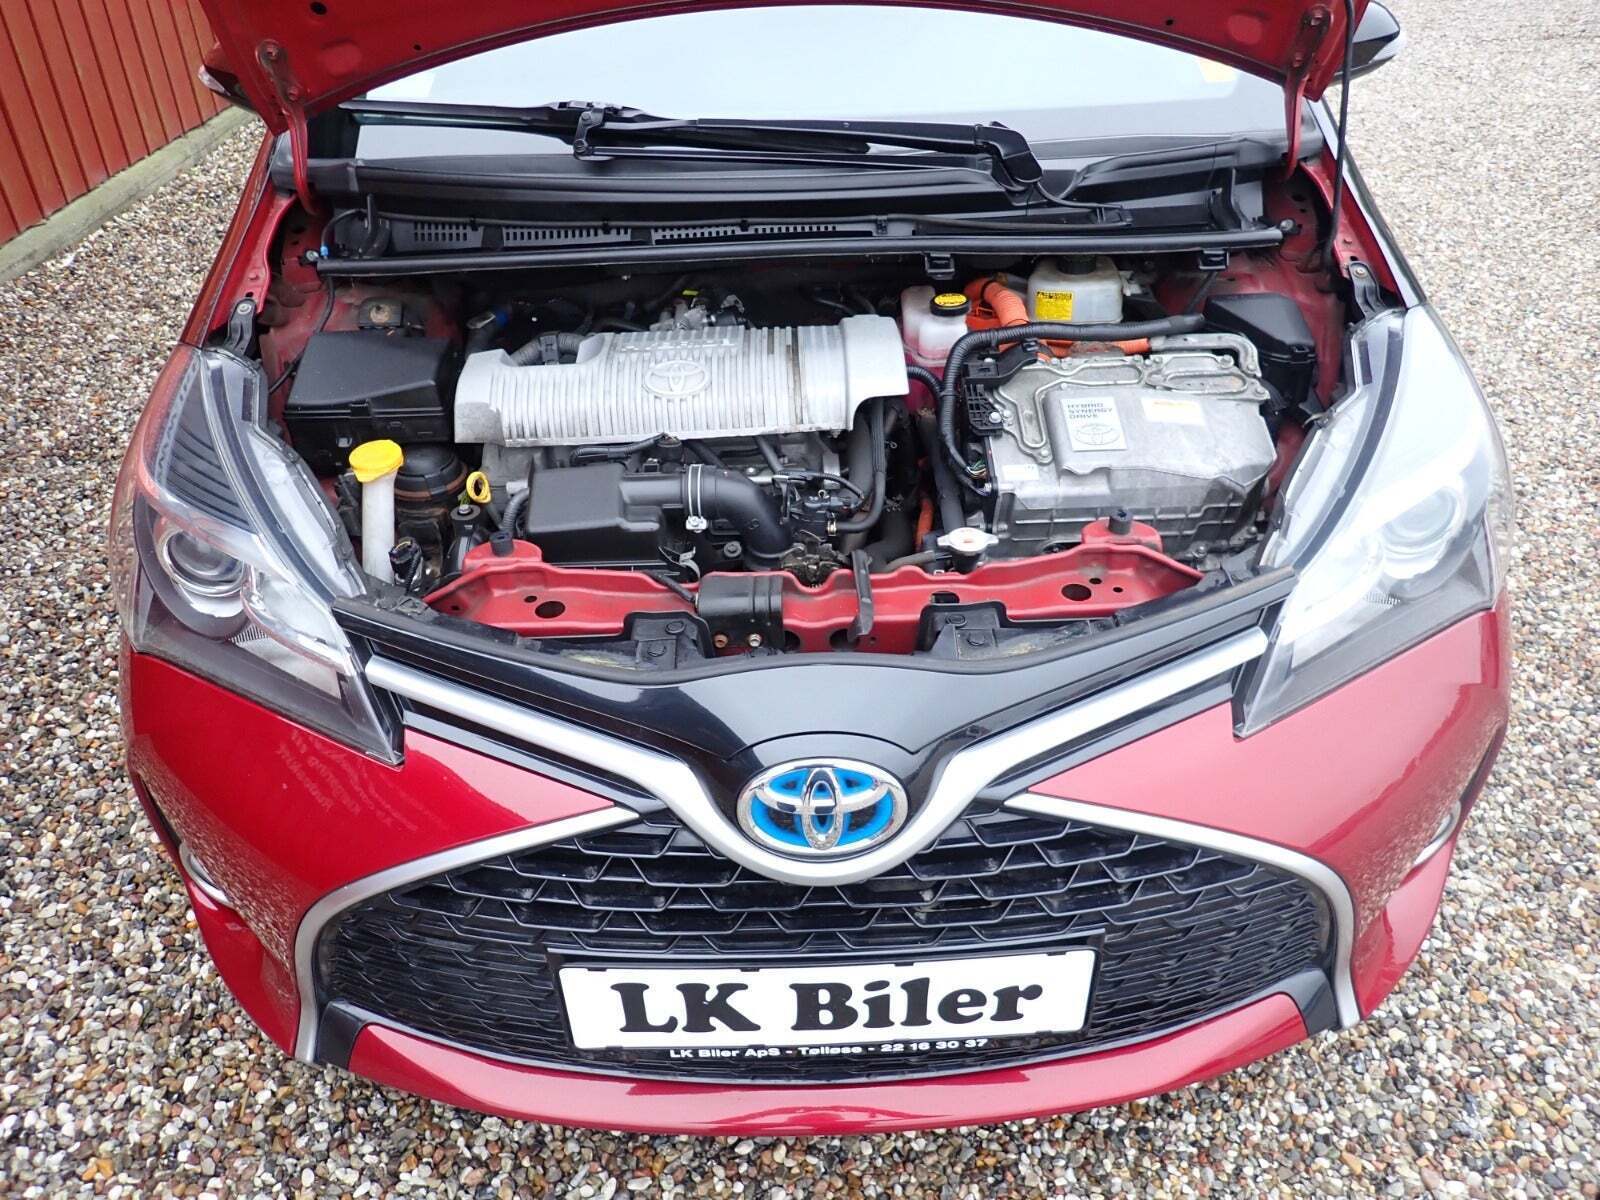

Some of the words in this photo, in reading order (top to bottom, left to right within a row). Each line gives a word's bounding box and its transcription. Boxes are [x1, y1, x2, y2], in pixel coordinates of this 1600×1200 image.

[609, 982, 762, 1033] LK
[788, 976, 1045, 1032] Biler
[669, 1049, 694, 1058] LK
[698, 1048, 740, 1058] Biler
[744, 1047, 781, 1059] ApS
[881, 1043, 905, 1052] 22
[935, 1040, 960, 1049] 30
[964, 1038, 989, 1048] 37
